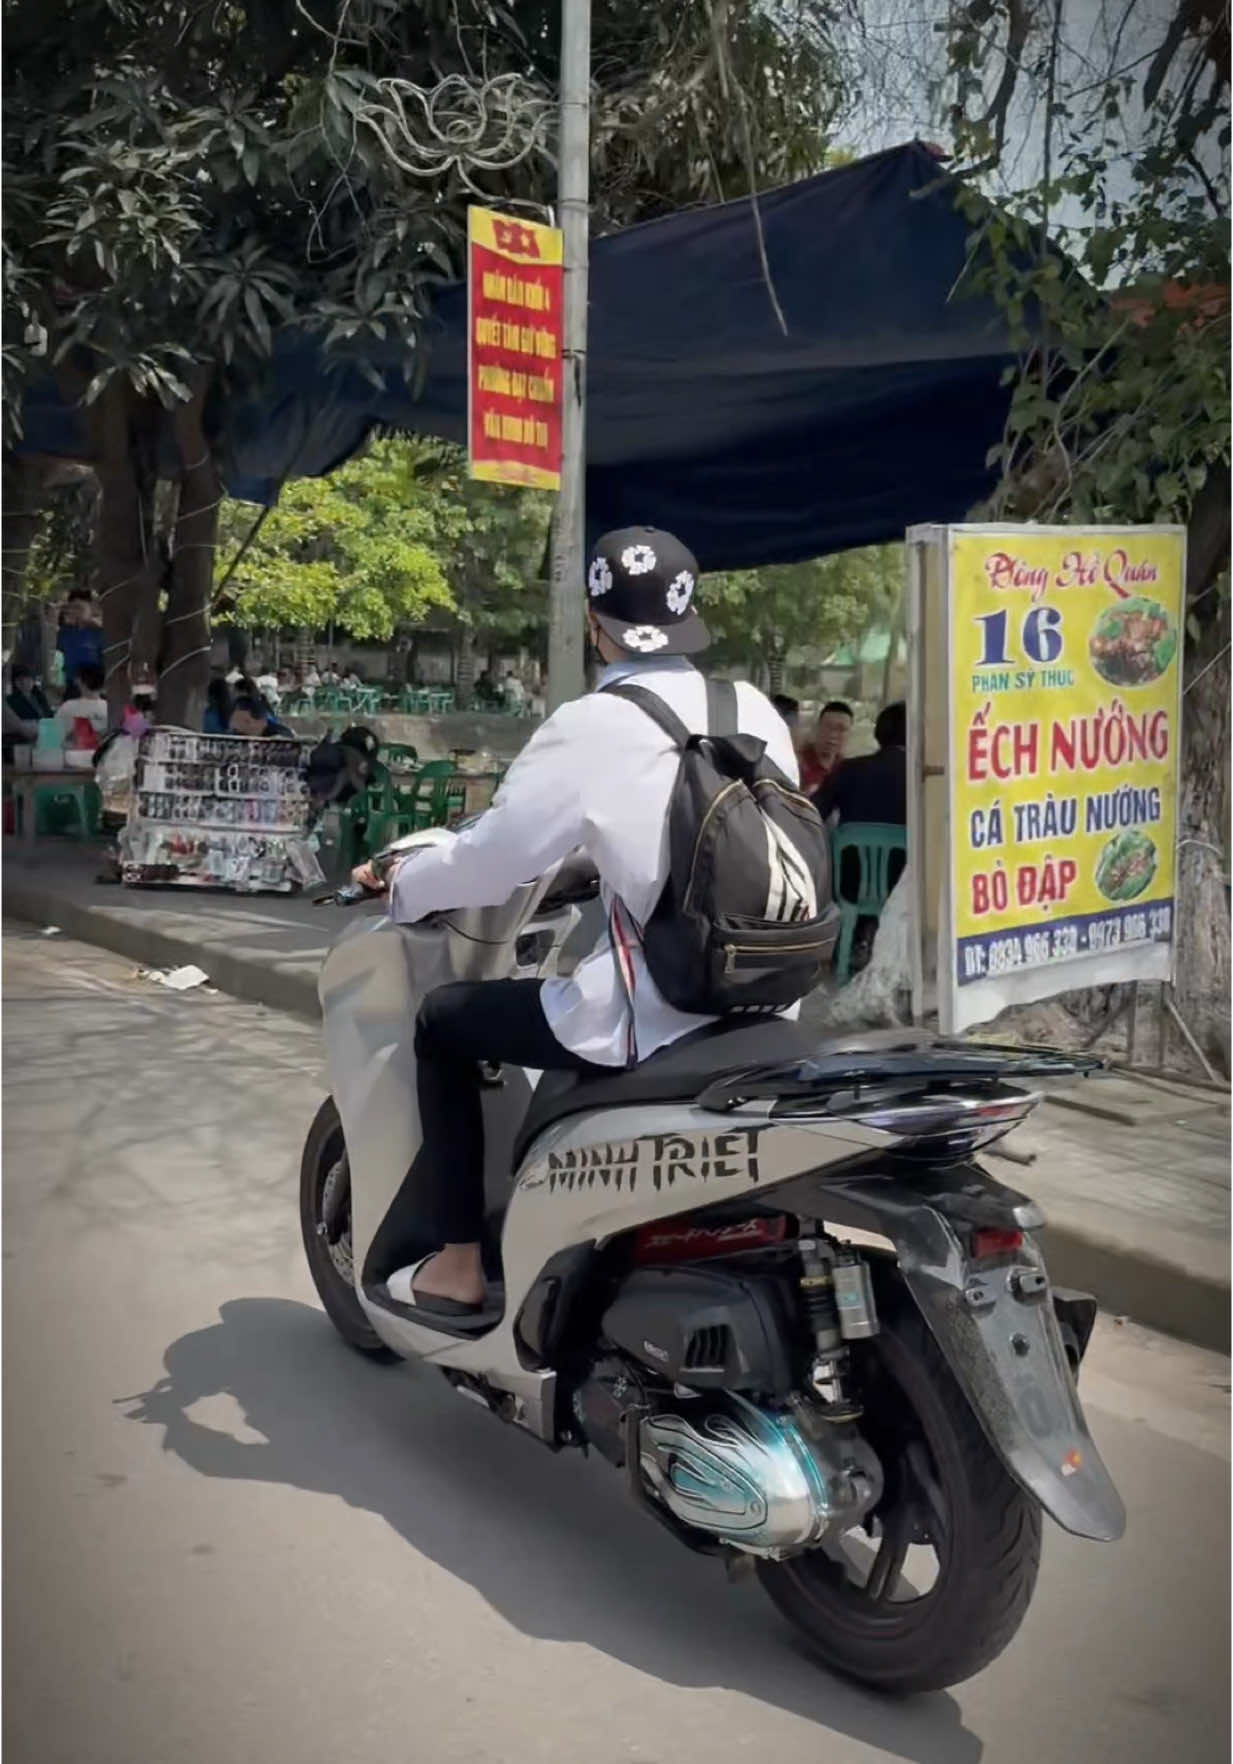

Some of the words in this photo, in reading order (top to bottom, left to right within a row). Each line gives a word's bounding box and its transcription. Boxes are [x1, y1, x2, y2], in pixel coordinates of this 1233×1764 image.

[974, 606, 1063, 667] 16
[972, 673, 1009, 692] PHAN
[969, 701, 1039, 781] ẾCH
[1051, 697, 1168, 772] NƯỚNG
[970, 800, 1002, 848] CÁ
[1014, 793, 1077, 842] TRÀU
[1086, 784, 1161, 833] NƯỚNG
[548, 1140, 640, 1193] MINH
